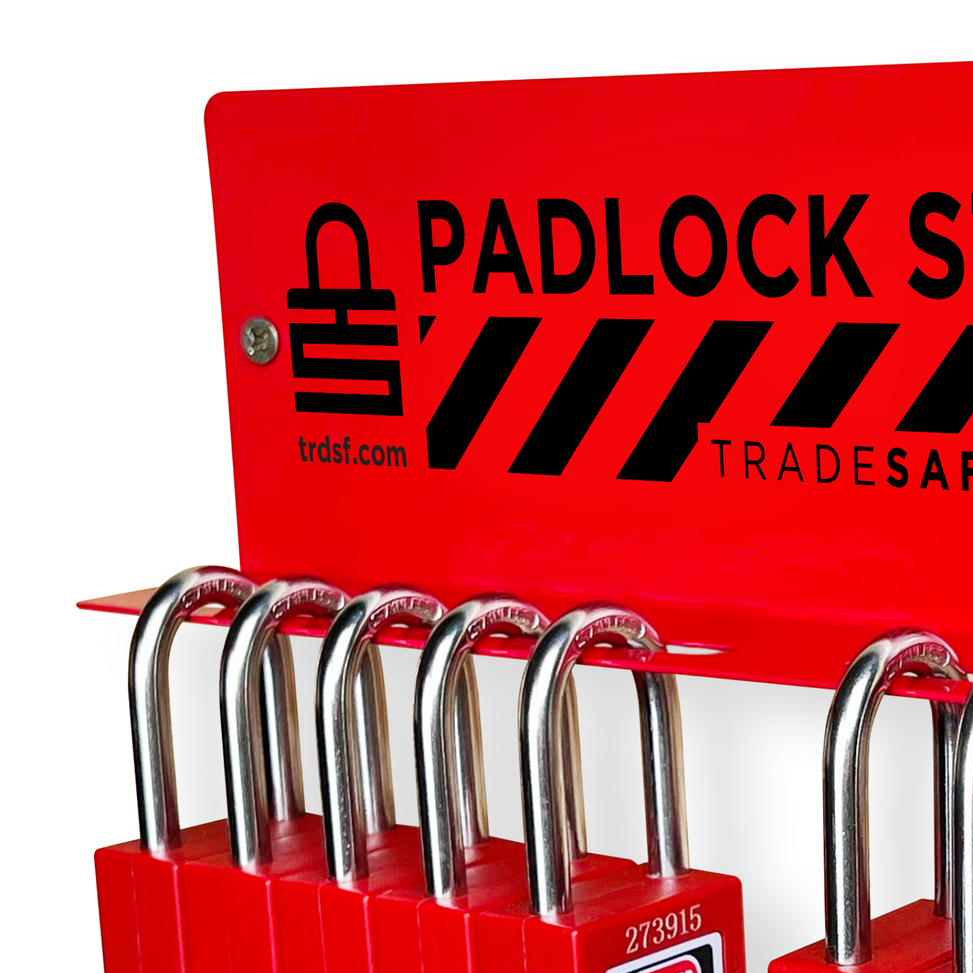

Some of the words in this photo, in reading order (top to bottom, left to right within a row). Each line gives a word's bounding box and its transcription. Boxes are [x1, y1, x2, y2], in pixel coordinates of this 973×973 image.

[418, 194, 874, 299] PADLOCK
[298, 435, 408, 469] trdsf.com
[625, 903, 703, 955] 273915
